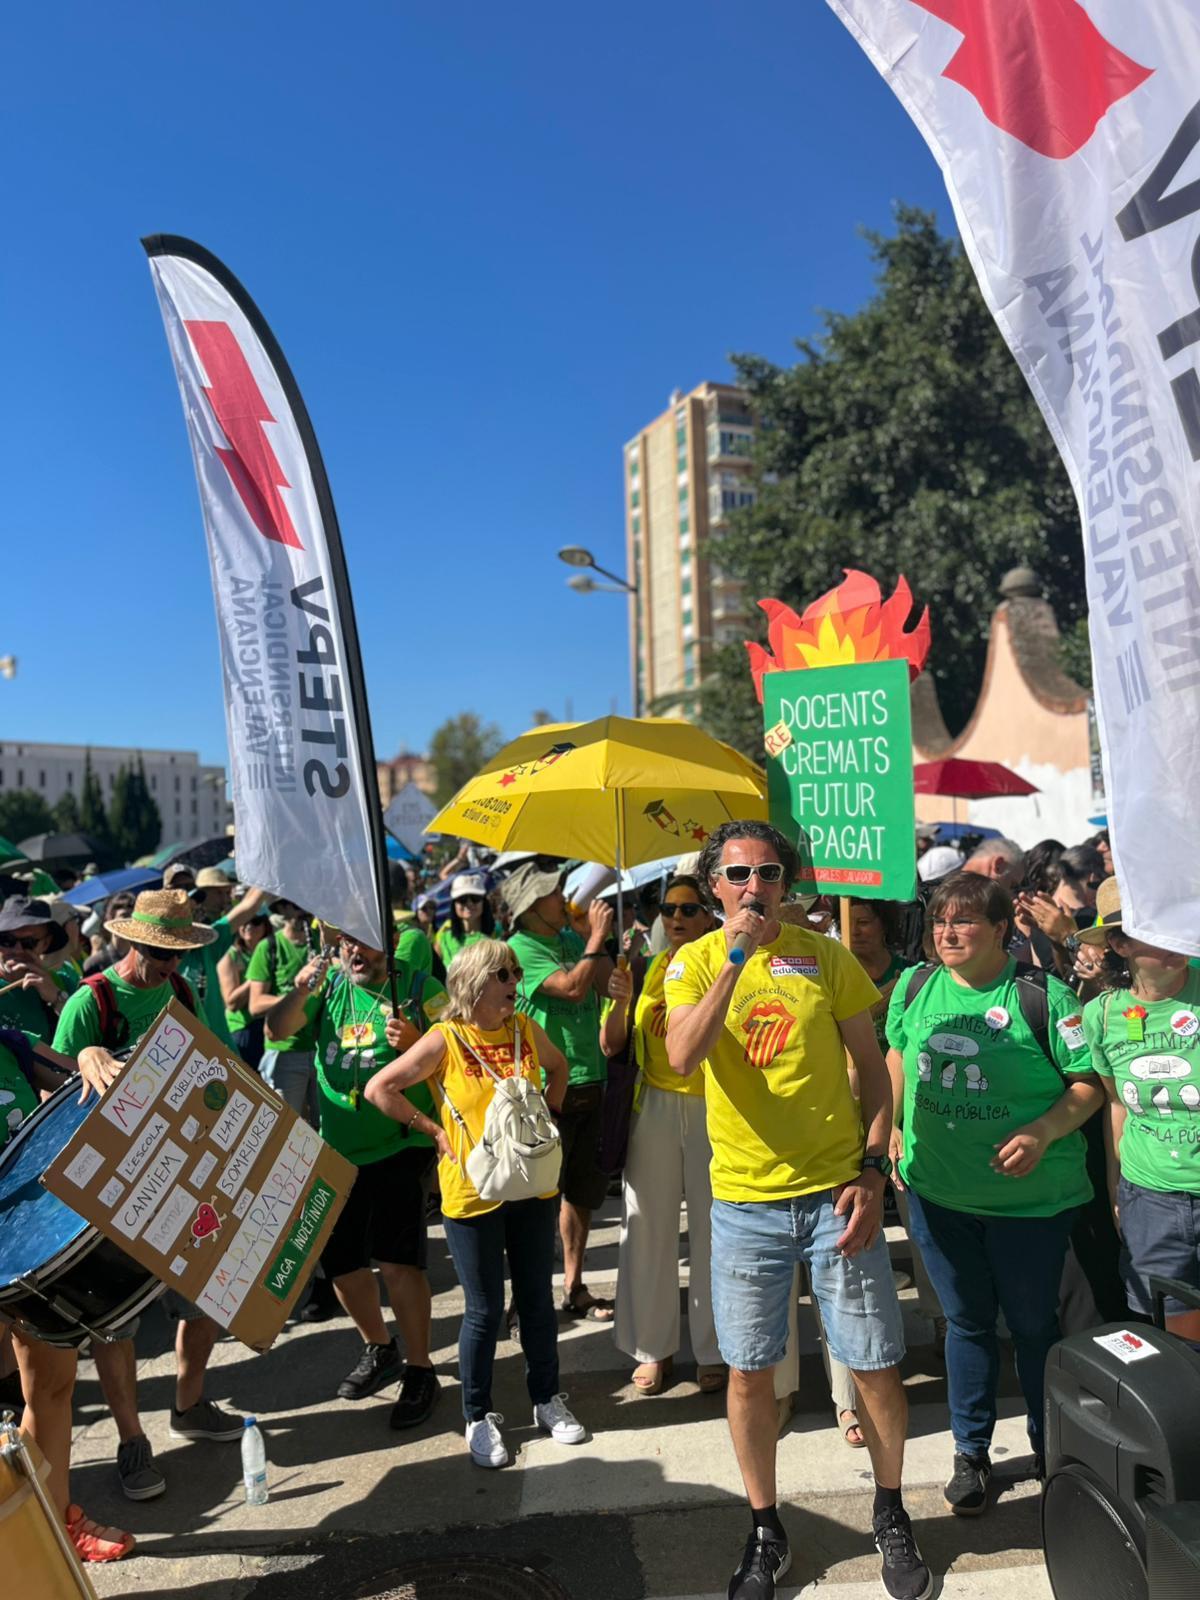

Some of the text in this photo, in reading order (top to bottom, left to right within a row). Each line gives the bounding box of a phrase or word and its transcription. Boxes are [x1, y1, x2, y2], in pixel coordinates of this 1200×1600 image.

[779, 689, 888, 730] DOCENTS
[765, 724, 790, 754] RE
[782, 736, 890, 776] CREMATS
[799, 783, 876, 817] FUTUR
[796, 825, 886, 860] APAGAT
[732, 989, 757, 1014] lluitar
[768, 985, 799, 1004] educar
[111, 1022, 188, 1128] MESTRES
[125, 1123, 164, 1176] L'ESCOLA
[170, 1058, 204, 1104] PÚBLICA
[216, 1098, 248, 1145] LLAPIS
[221, 1108, 276, 1195] SOMRIURES
[123, 1155, 181, 1227] CANVIEM
[271, 1186, 331, 1291] VAGA INDEFINIDA
